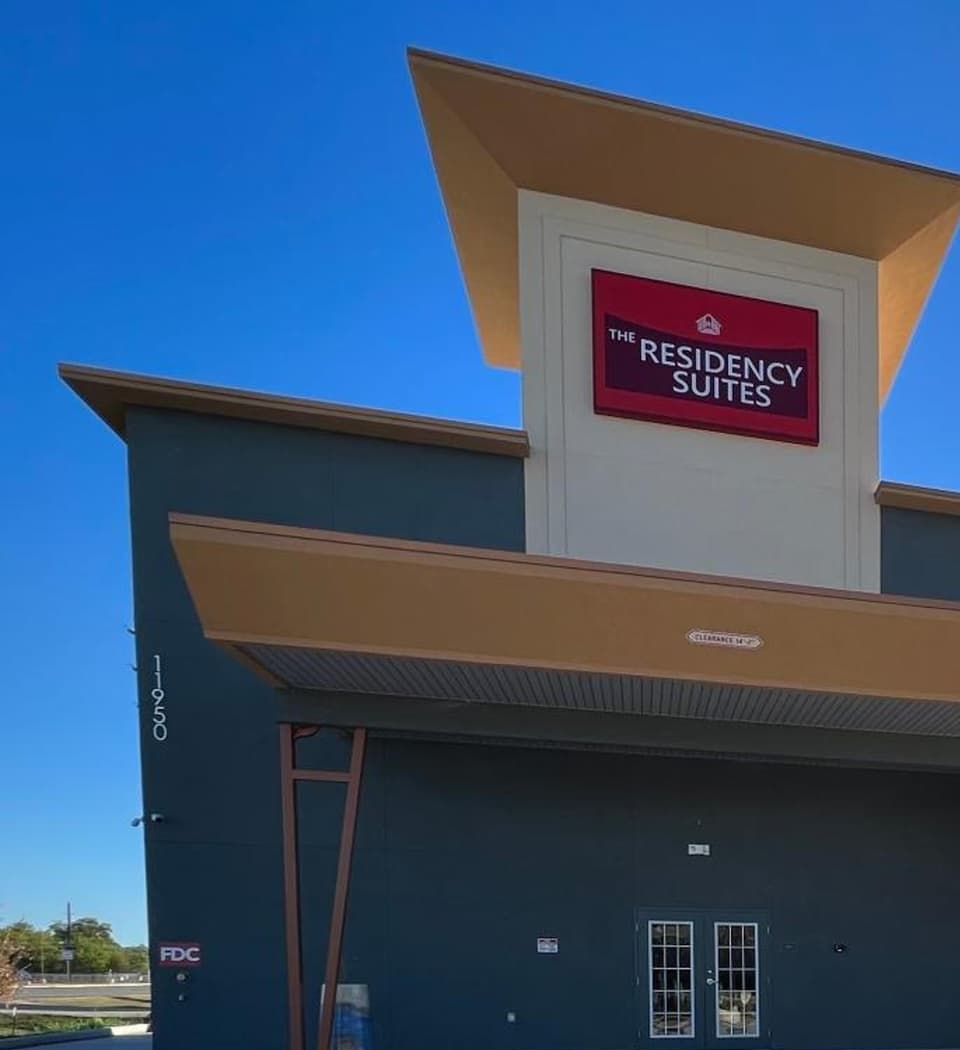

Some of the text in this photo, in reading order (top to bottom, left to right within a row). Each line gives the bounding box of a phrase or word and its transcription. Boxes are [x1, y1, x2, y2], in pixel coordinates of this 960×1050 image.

[608, 328, 803, 388] THE RESIDENCY
[672, 371, 772, 408] SUITES
[695, 633, 734, 643] CLEARANCE
[151, 654, 168, 741] 11950
[160, 946, 201, 962] FDC
